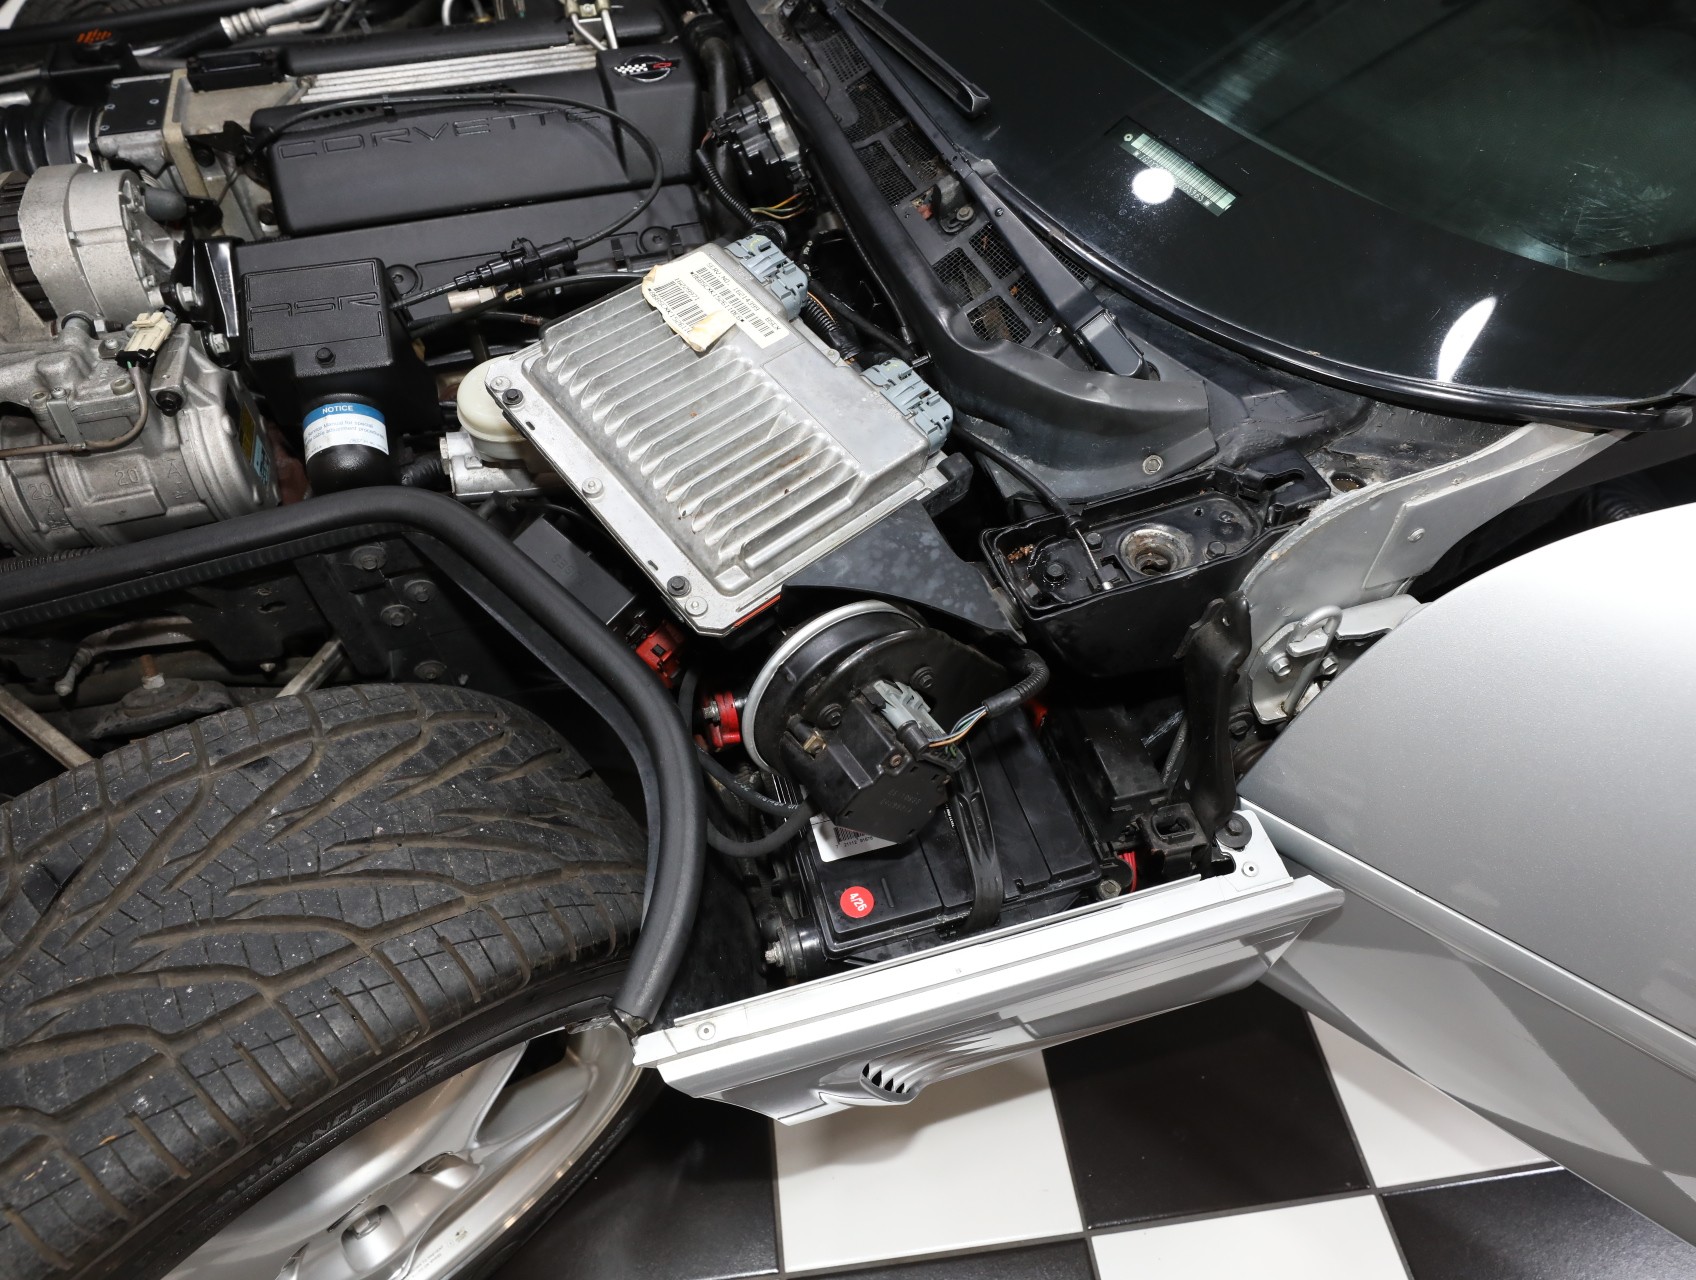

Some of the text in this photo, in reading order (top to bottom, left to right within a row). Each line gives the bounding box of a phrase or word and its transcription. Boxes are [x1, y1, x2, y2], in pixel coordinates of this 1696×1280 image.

[279, 106, 601, 159] CORVETTE
[322, 405, 354, 414] NOTICE
[115, 468, 139, 487] 20
[849, 892, 868, 912] 4/26
